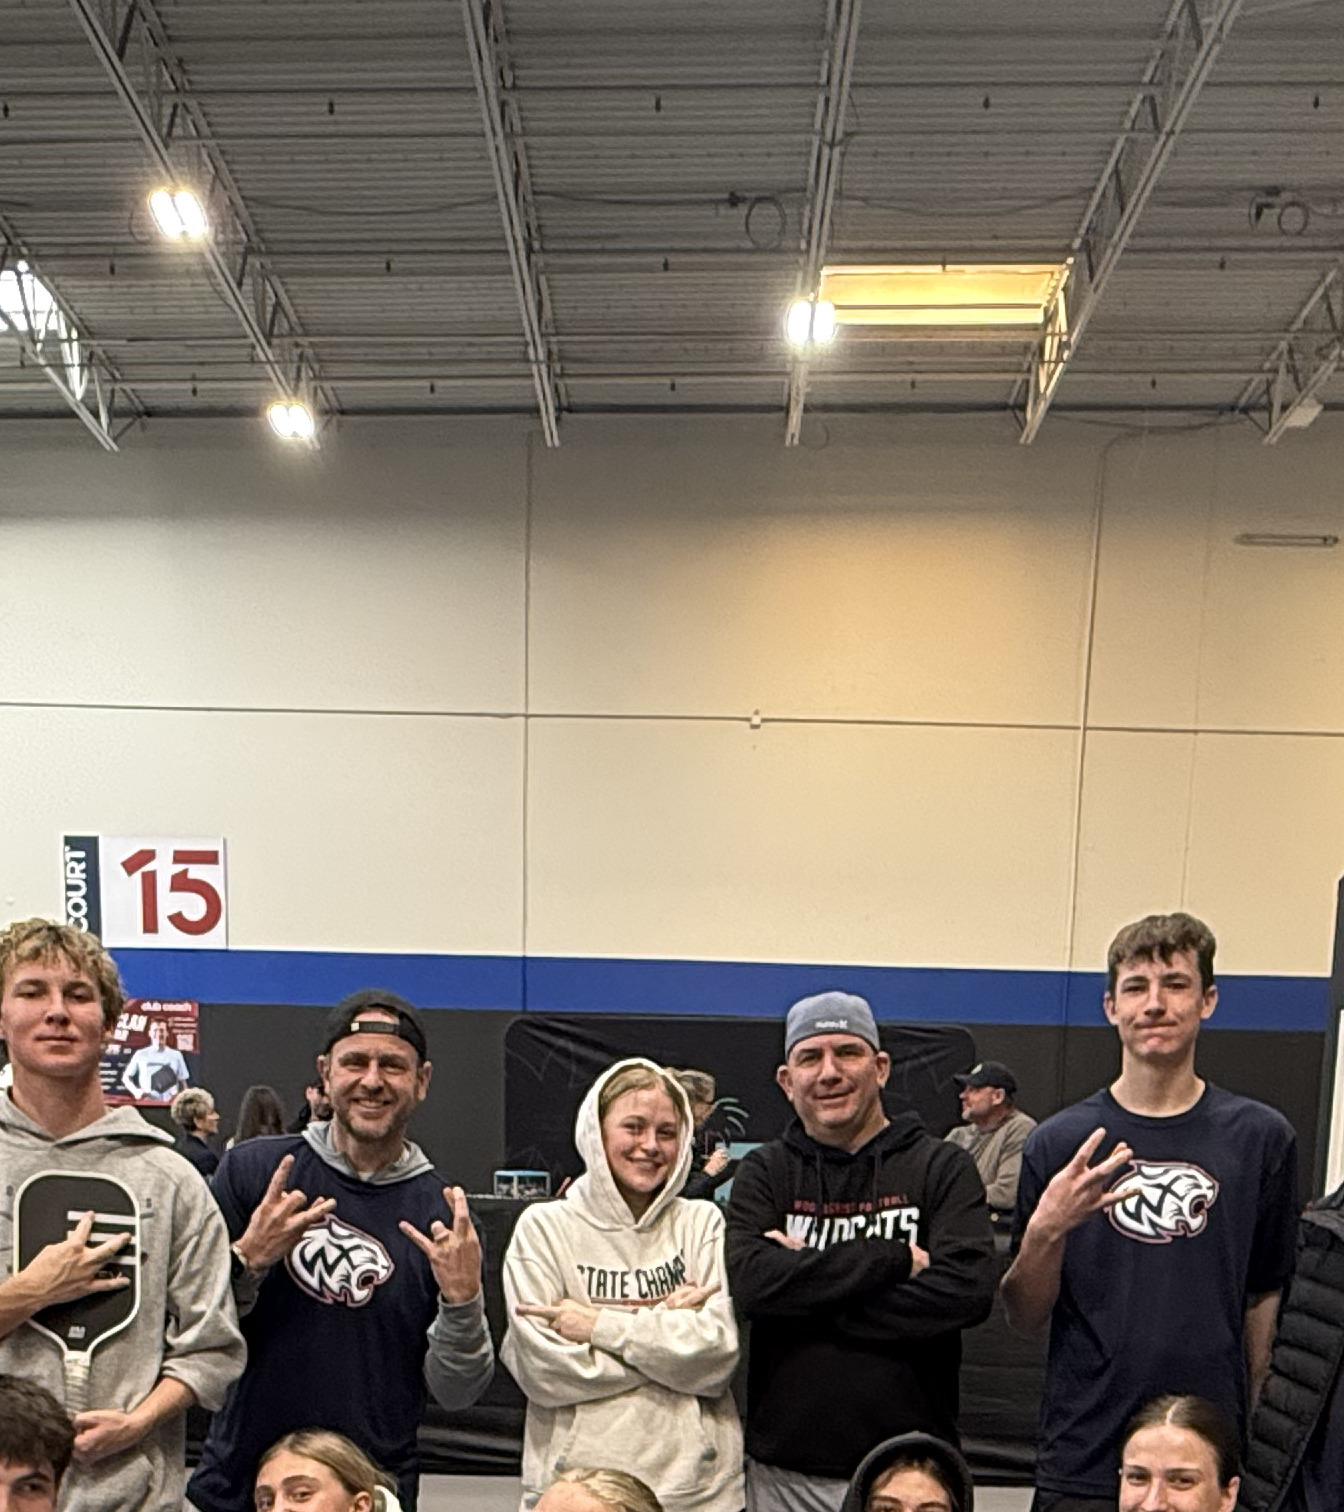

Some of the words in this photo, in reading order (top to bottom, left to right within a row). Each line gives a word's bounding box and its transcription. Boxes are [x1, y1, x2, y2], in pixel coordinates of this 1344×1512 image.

[64, 845, 89, 933] COURT
[119, 849, 223, 936] 15
[577, 1264, 630, 1299] TATE
